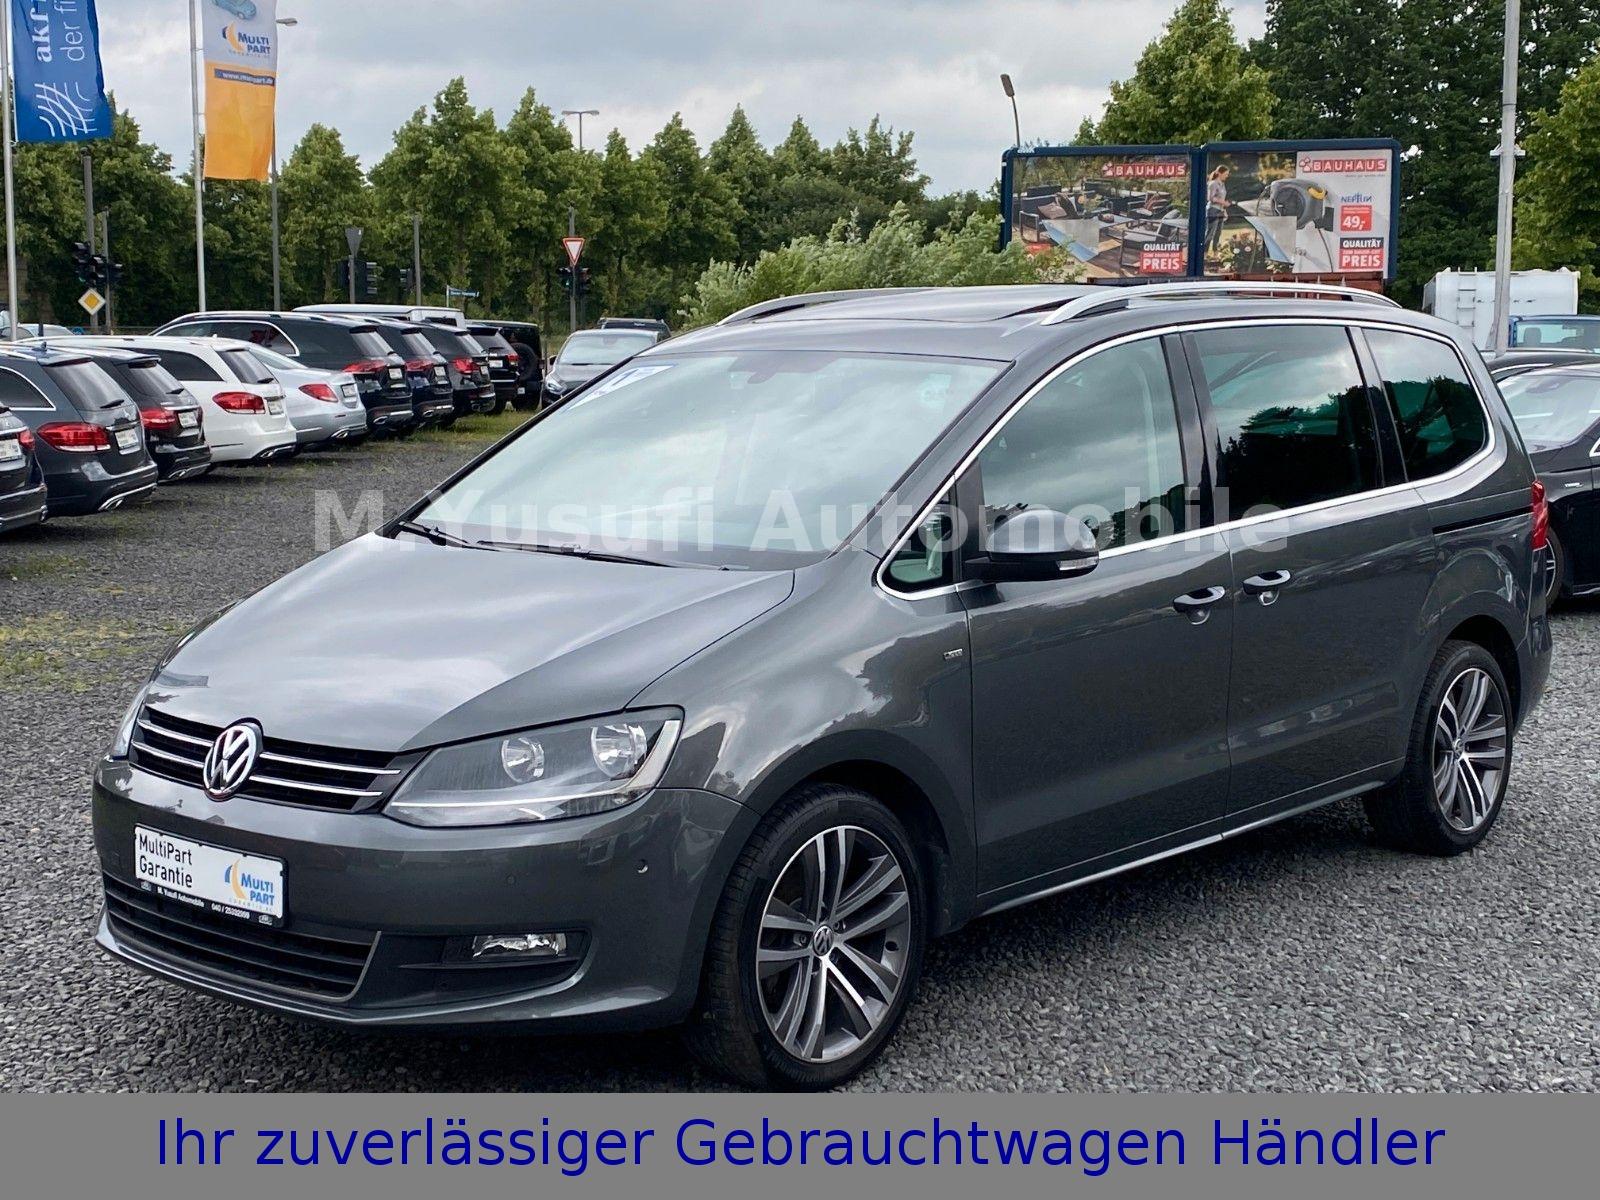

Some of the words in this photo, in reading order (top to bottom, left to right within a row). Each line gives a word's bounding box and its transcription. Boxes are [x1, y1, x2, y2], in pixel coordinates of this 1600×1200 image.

[30, 7, 52, 62] akf
[60, 21, 85, 61] der
[238, 32, 270, 45] MULTI
[247, 44, 271, 54] PART
[1114, 163, 1187, 176] BAUHAUS
[1312, 159, 1387, 172] BAUHAUS
[1143, 241, 1180, 251] QUALITÄT
[1343, 239, 1381, 249] QUALITÄT
[1142, 258, 1180, 270] PREIS
[1342, 254, 1381, 268] PREIS
[139, 833, 193, 865] MultiPart
[139, 855, 193, 888] Garantie
[241, 872, 274, 893] MULTI
[250, 890, 275, 906] PART
